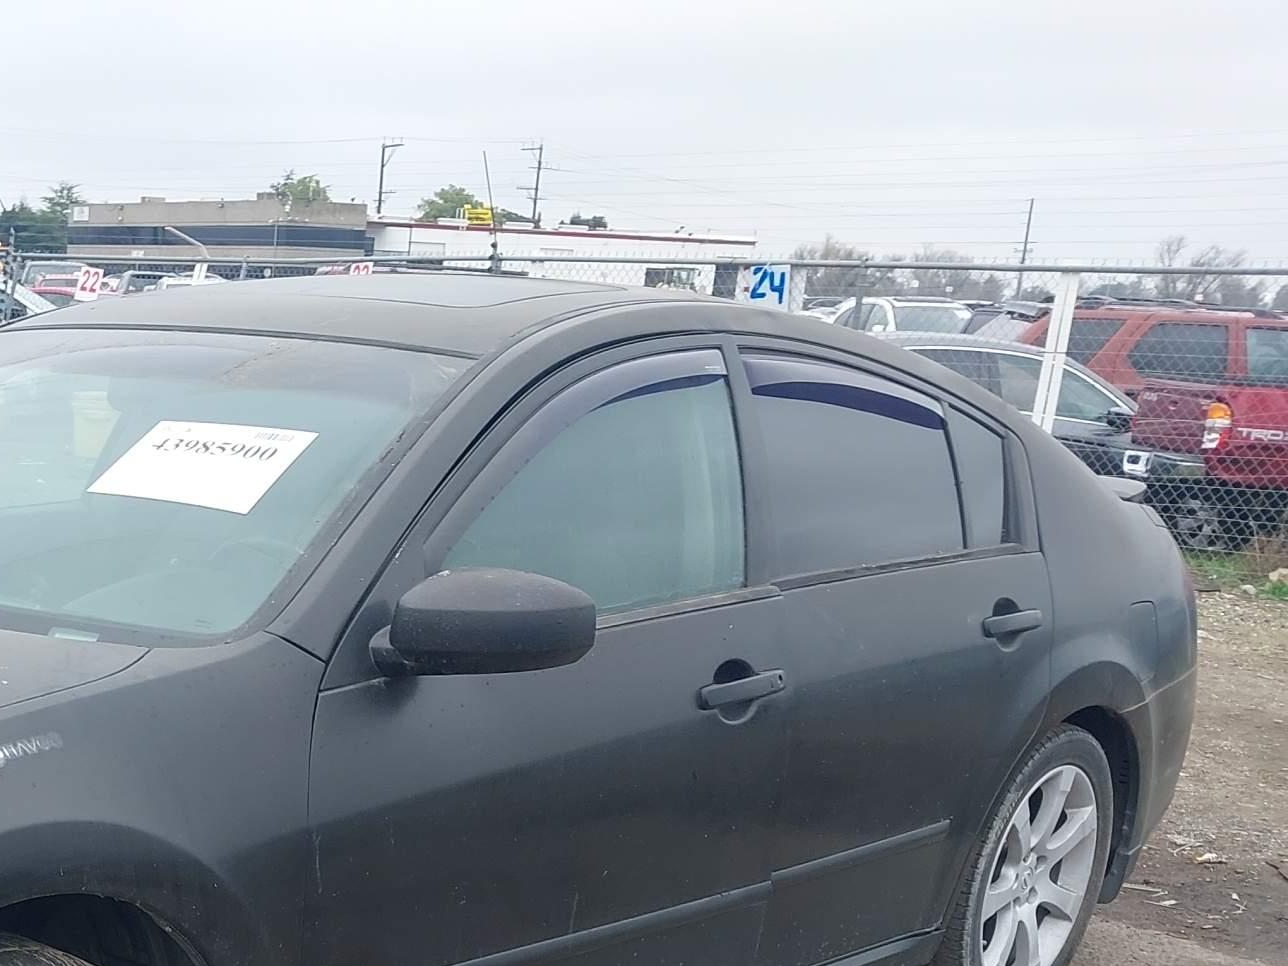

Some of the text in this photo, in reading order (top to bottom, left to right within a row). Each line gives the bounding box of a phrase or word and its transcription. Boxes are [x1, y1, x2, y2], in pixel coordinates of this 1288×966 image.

[80, 269, 100, 293] 22
[750, 266, 786, 304] 24
[152, 437, 278, 461] 43985900
